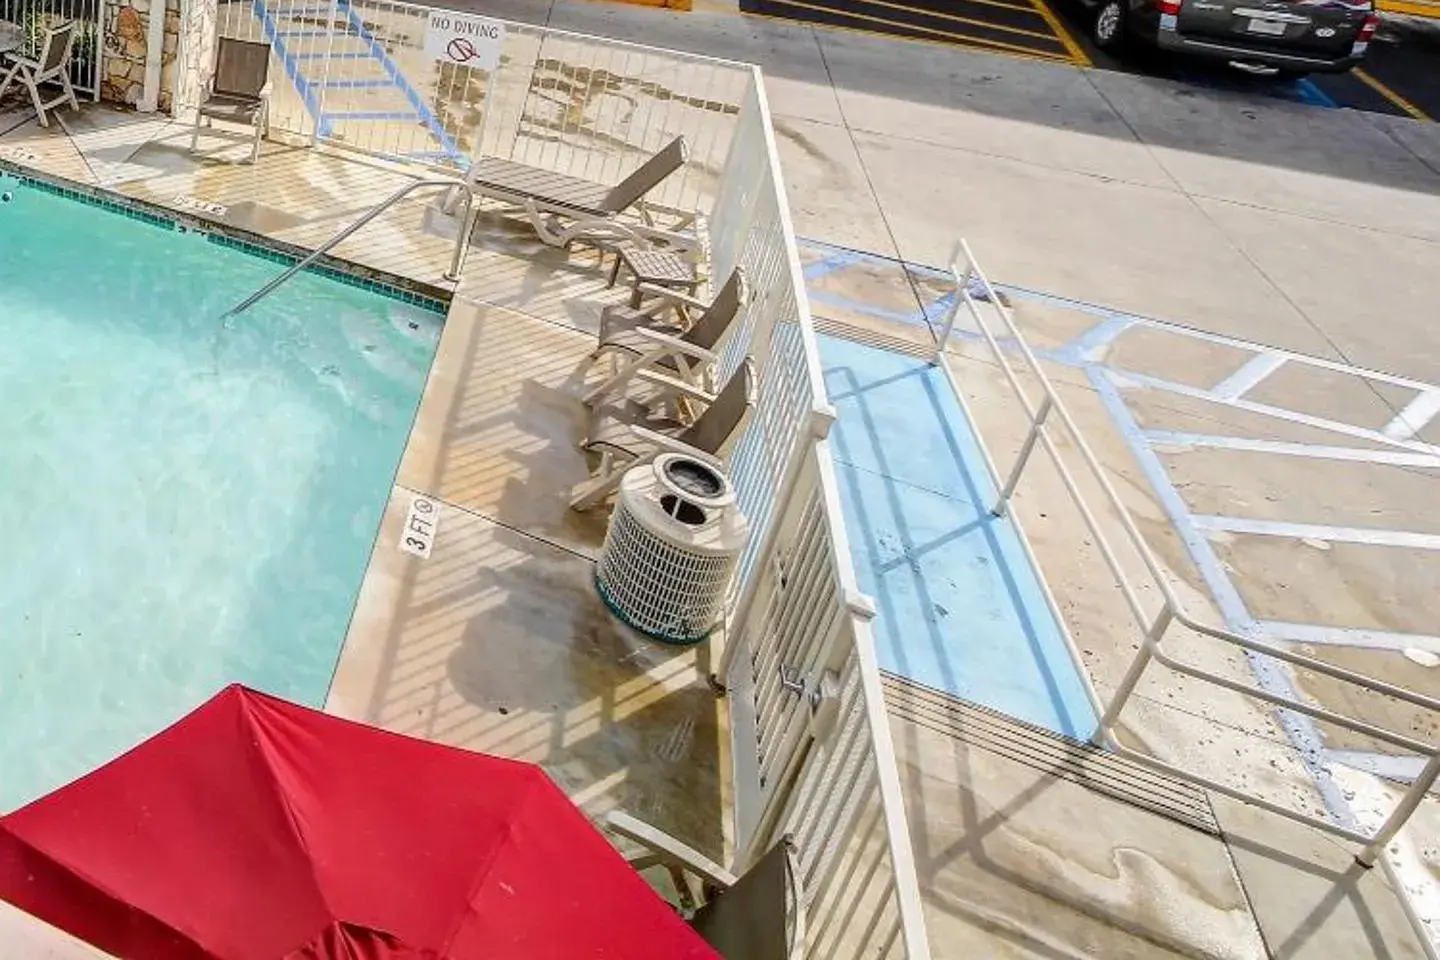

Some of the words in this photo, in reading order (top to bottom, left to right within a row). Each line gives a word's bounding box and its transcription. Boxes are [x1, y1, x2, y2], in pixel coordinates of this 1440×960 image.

[431, 16, 450, 30] NO
[454, 20, 499, 40] DIVING
[409, 514, 433, 536] FT
[406, 536, 427, 551] 3
